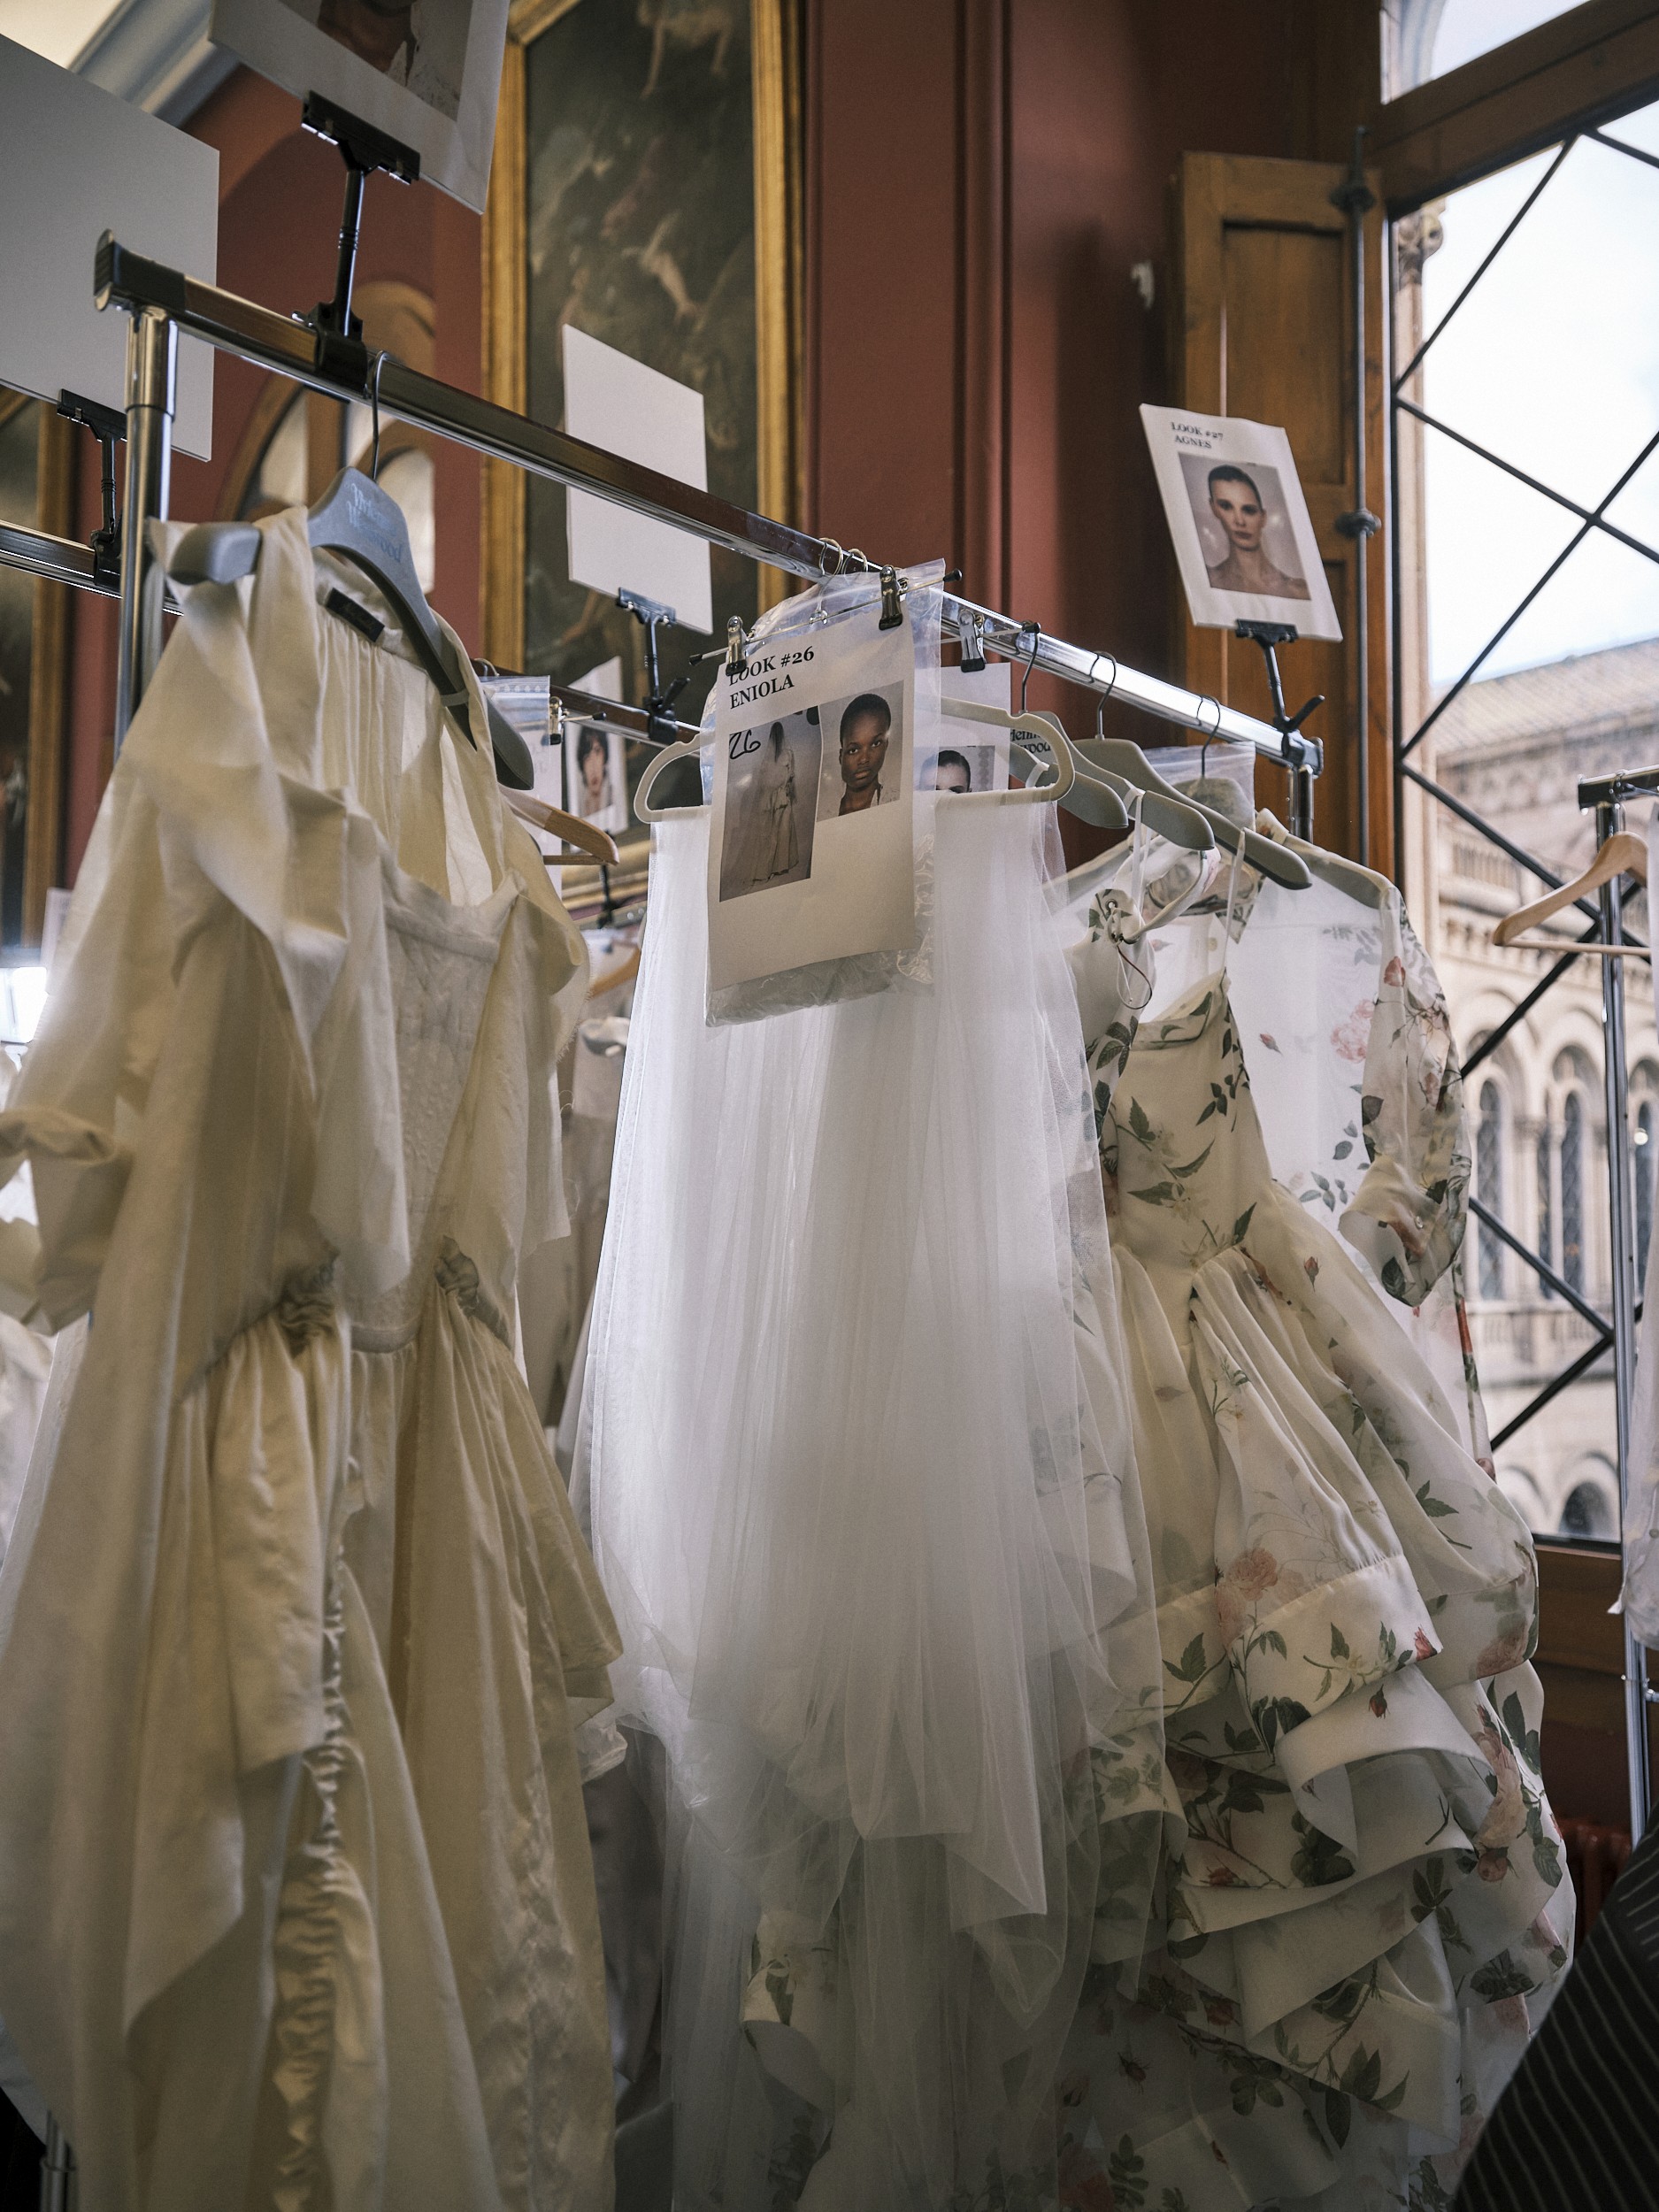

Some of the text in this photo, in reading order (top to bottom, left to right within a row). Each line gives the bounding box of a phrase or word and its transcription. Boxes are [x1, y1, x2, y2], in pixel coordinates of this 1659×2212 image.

[1171, 421, 1202, 436] LOOK
[1174, 434, 1212, 449] AGNES
[780, 645, 815, 668] #26
[729, 673, 795, 710] ENIOLA
[728, 728, 762, 760] 26
